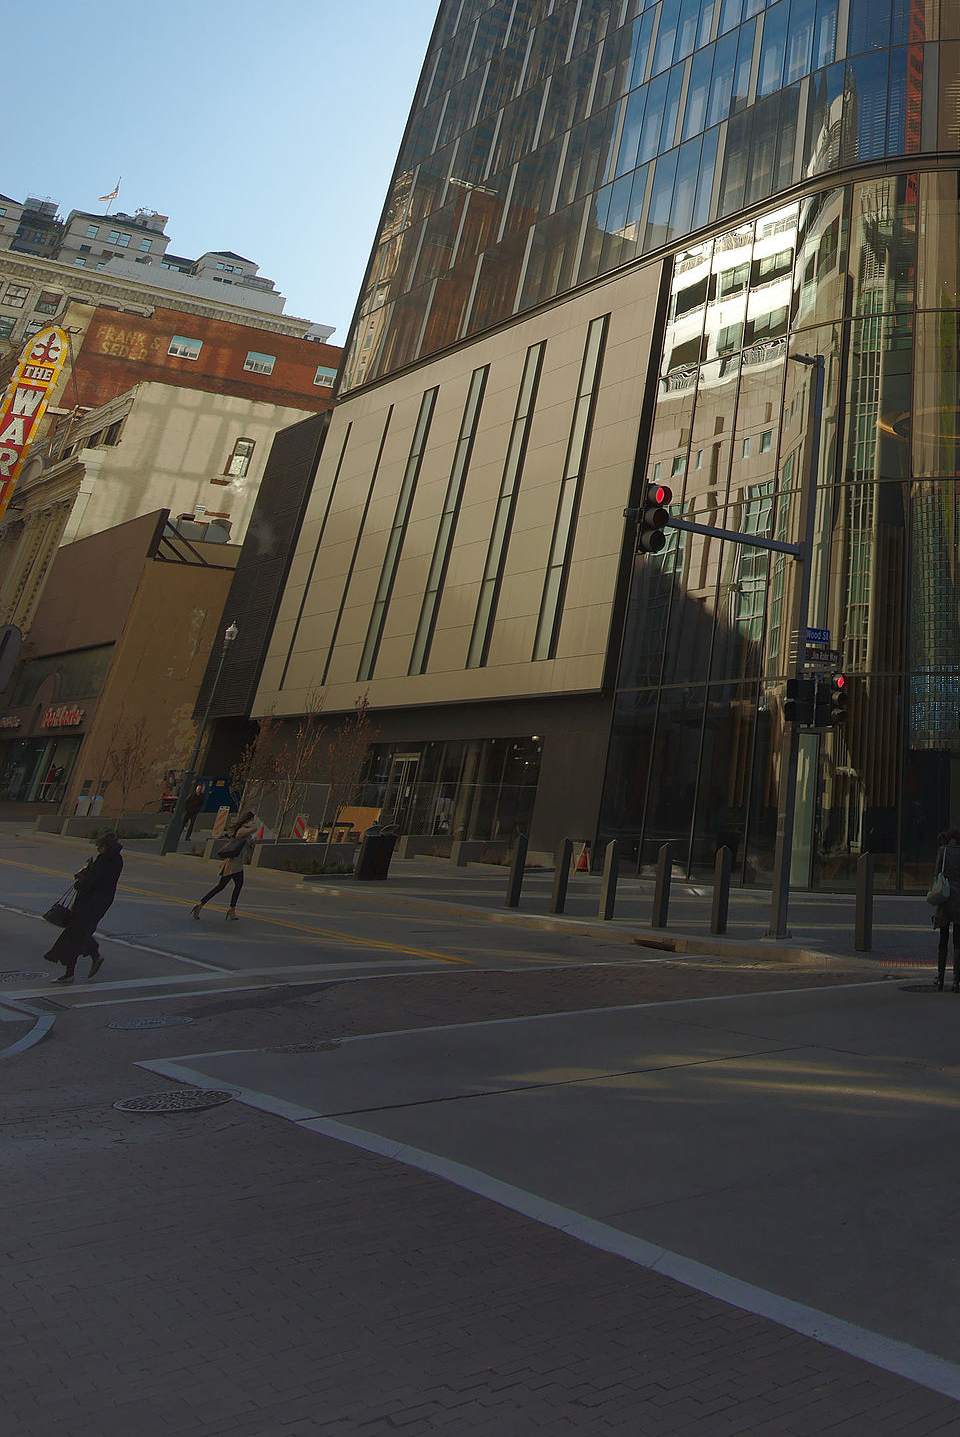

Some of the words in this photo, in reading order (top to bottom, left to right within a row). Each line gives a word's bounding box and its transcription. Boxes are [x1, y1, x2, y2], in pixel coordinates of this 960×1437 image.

[96, 325, 147, 347] FRANK
[150, 337, 160, 350] &
[23, 365, 54, 381] THE
